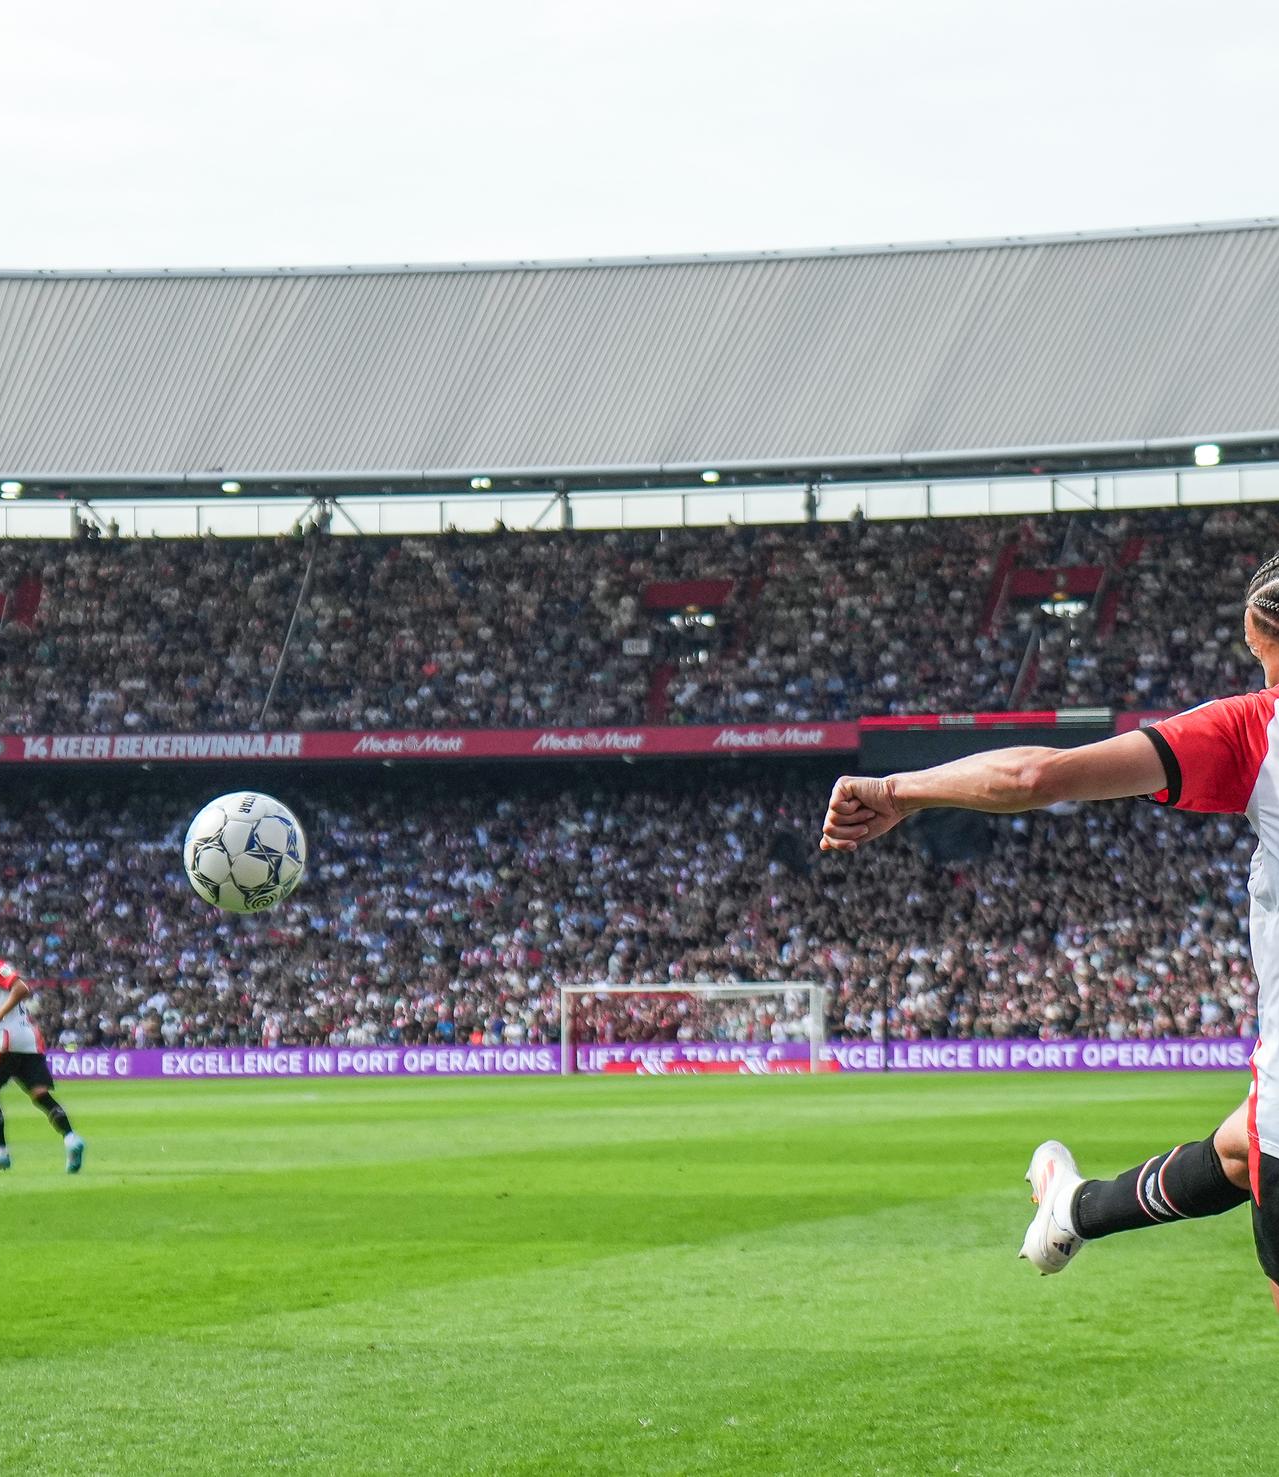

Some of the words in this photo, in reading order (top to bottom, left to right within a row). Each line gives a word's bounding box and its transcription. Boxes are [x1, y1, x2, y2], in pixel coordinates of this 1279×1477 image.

[22, 736, 48, 760] 14
[51, 735, 111, 759] KEER
[113, 734, 301, 758] BEKERWINNAAR
[46, 1054, 109, 1075] RADE
[161, 1052, 303, 1075] EXCELLENCE
[308, 1052, 334, 1074] IN
[337, 1050, 399, 1074] PORT
[404, 1049, 557, 1073] OPERATIONS.
[978, 1045, 1006, 1068] IN
[1010, 1043, 1078, 1067] PORT
[1082, 1042, 1250, 1067] OPERATIONS.
